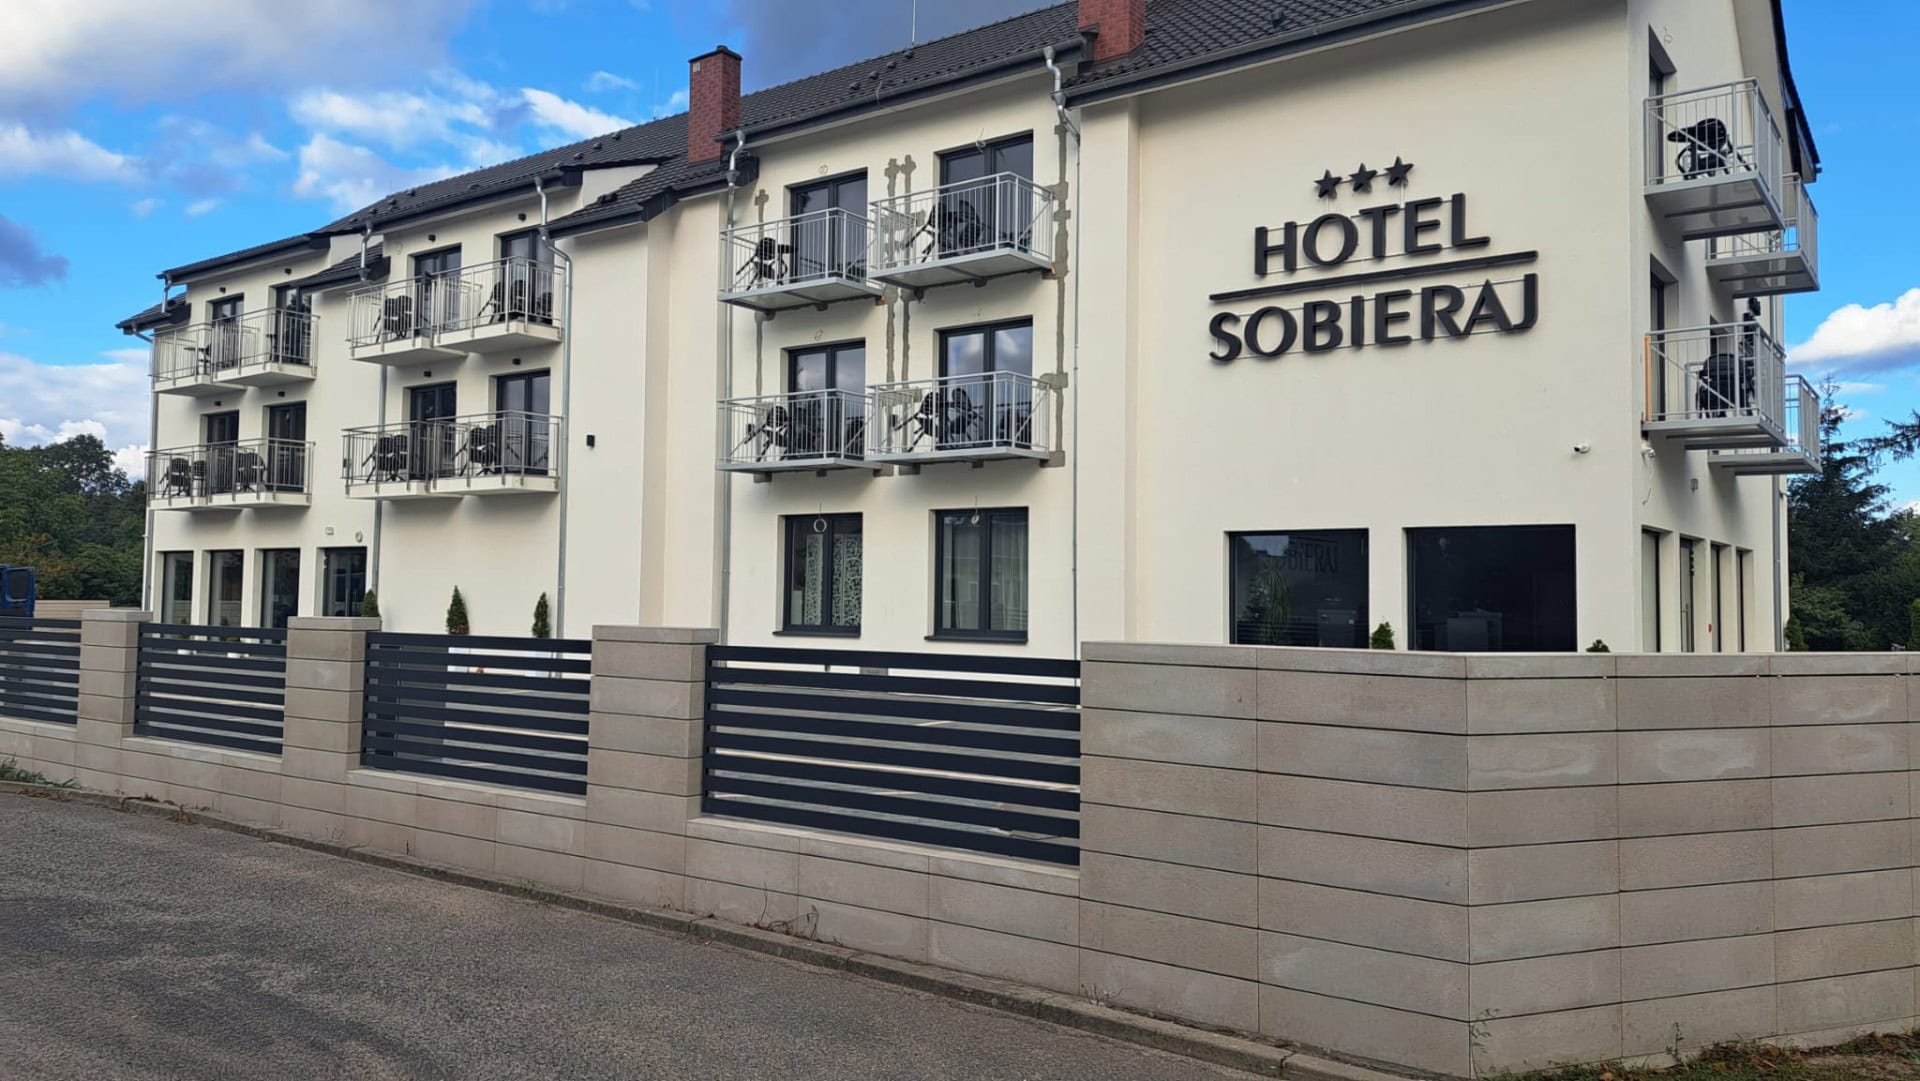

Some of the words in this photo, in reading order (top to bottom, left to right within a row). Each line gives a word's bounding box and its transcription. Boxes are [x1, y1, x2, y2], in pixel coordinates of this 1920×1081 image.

[1254, 192, 1491, 278] HOTEL
[1209, 273, 1539, 363] SOBIERAJ
[1281, 541, 1338, 574] BIERAJ
